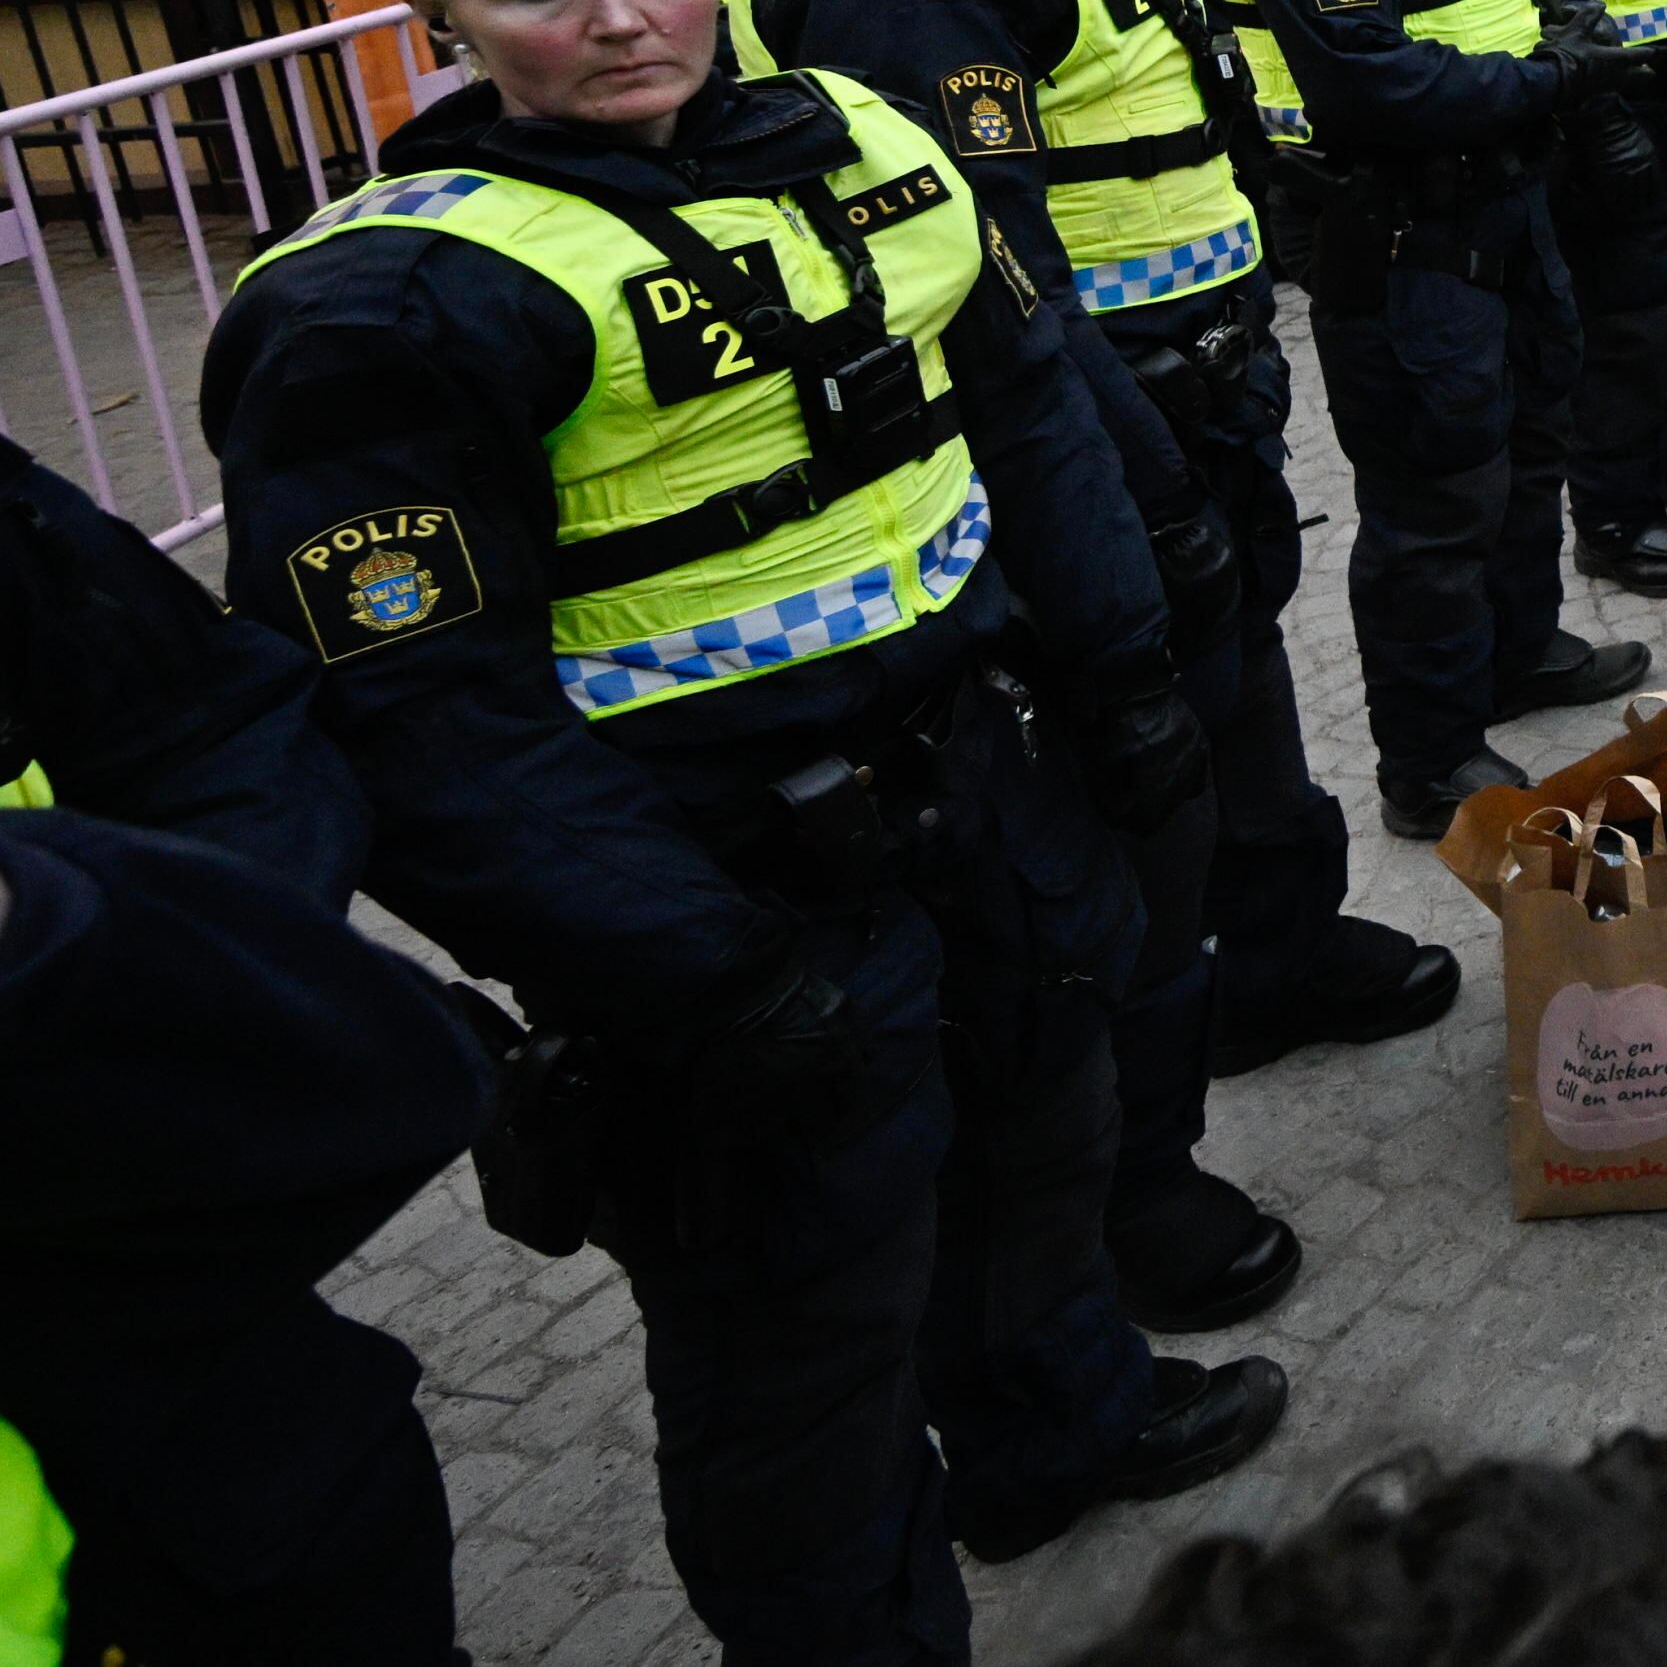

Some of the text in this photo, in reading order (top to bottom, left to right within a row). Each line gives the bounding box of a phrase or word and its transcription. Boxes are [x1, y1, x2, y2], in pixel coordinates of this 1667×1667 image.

[946, 70, 1017, 95] POLIS
[847, 176, 939, 226] OLIS
[702, 321, 755, 379] 2
[300, 513, 443, 572] POLIS
[1577, 1030, 1653, 1061] Från en
[1556, 1077, 1578, 1103] till
[1582, 1094, 1606, 1107] en
